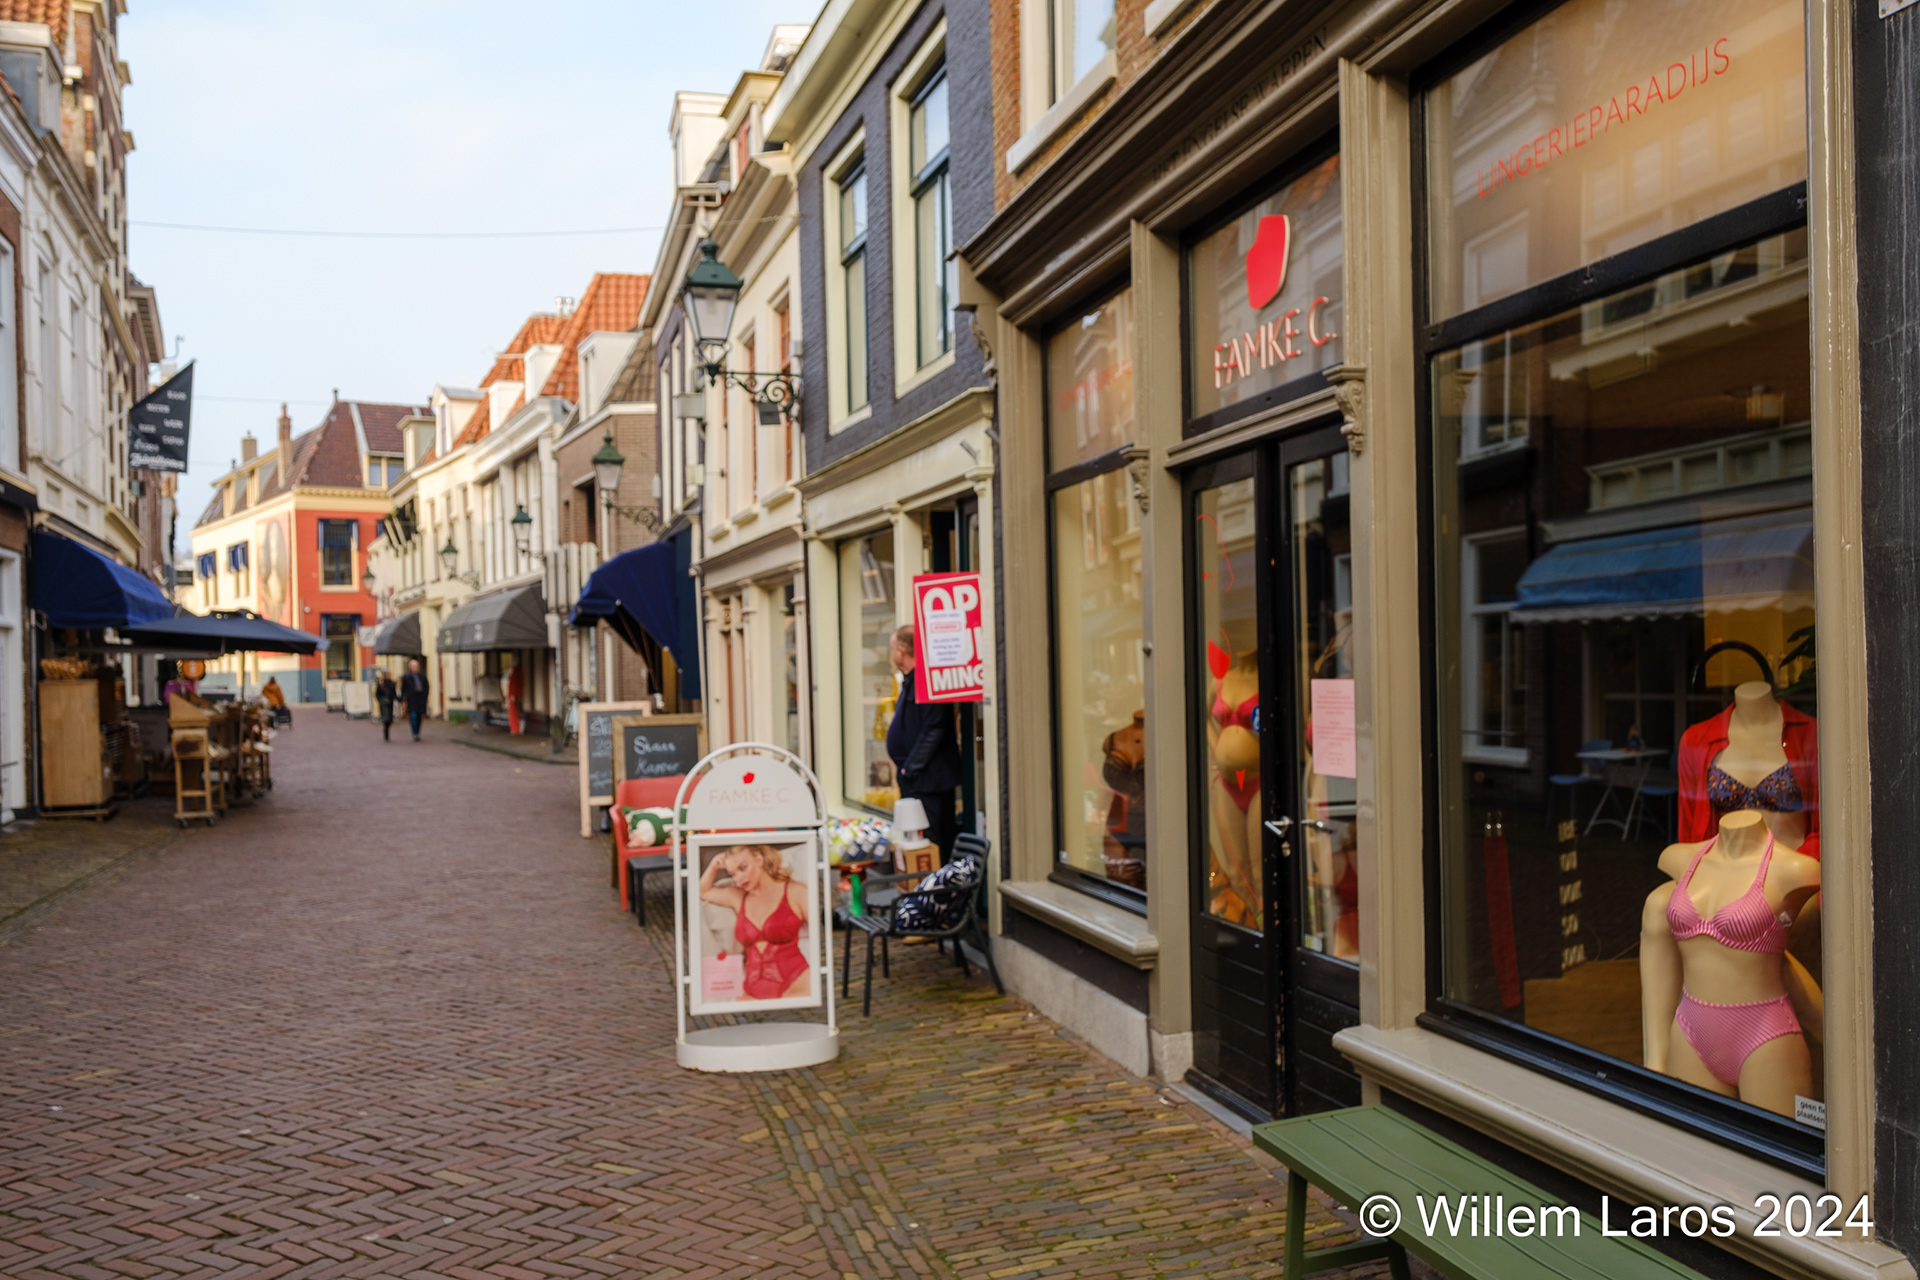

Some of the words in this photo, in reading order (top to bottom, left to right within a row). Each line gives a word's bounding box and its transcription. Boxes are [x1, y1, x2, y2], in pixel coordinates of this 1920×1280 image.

[1477, 37, 1730, 198] LINGERIEPARADIJS
[1213, 308, 1302, 389] FAMKE
[708, 787, 771, 804] FAMKE
